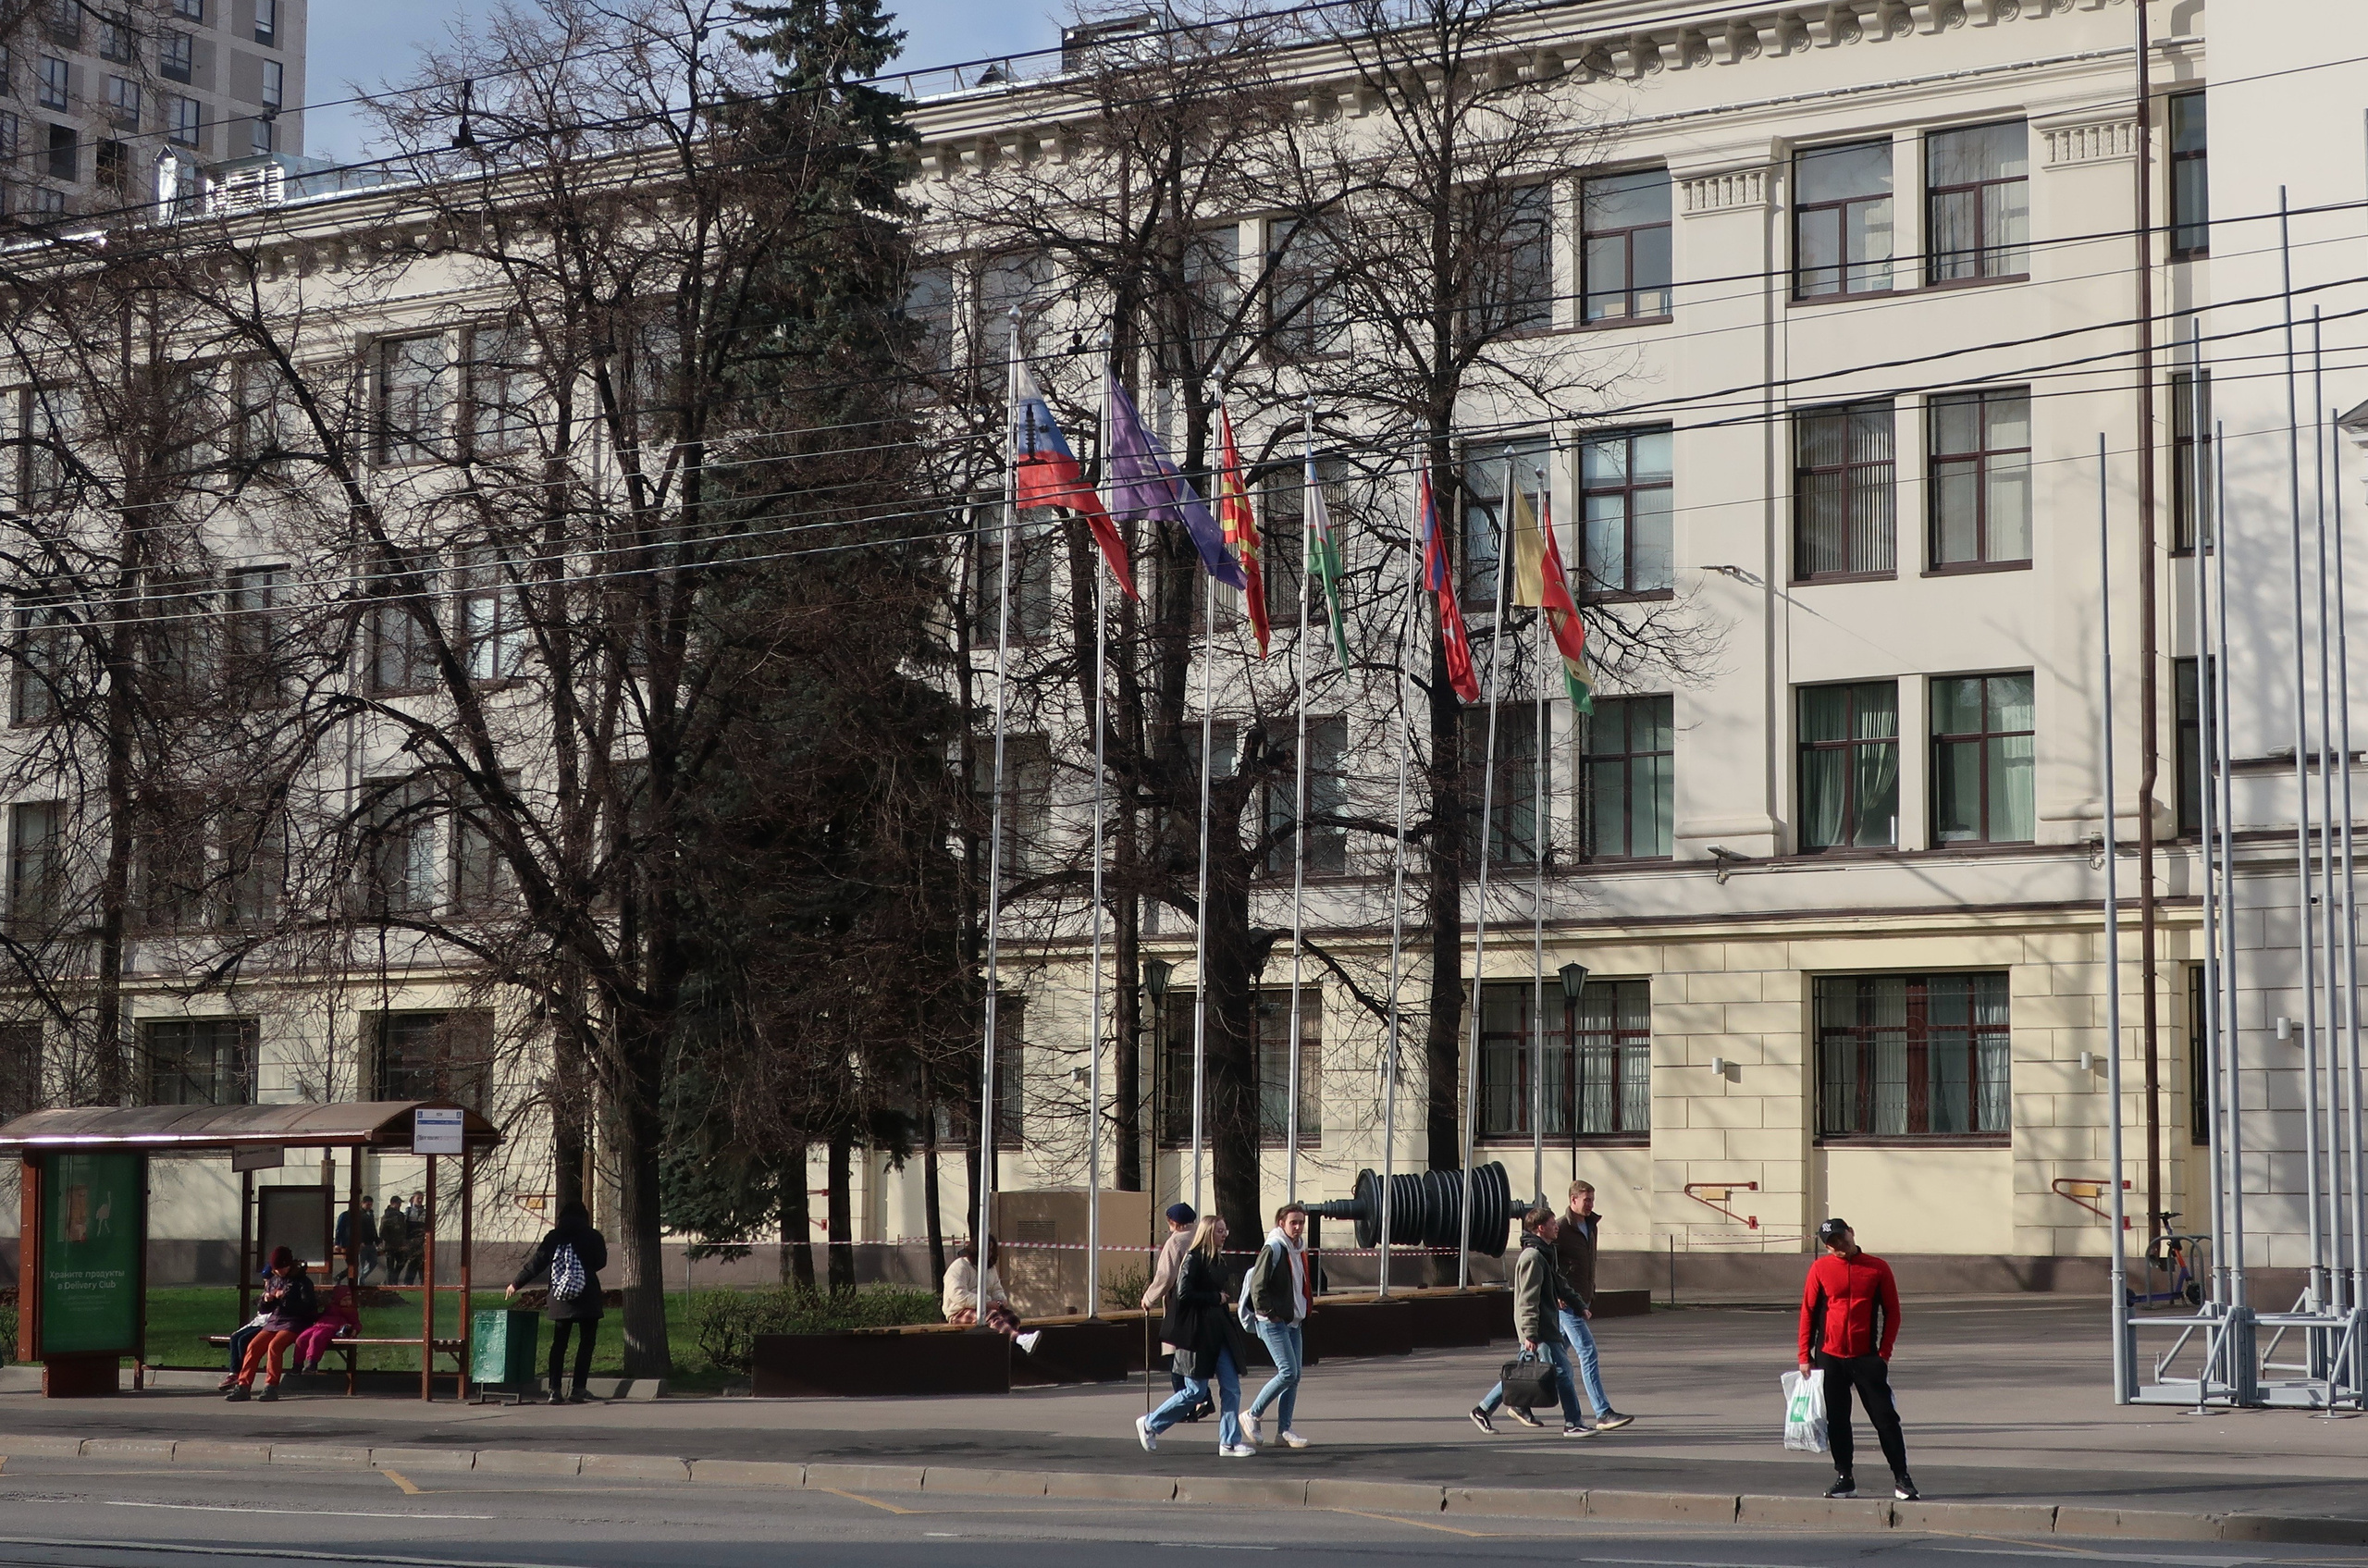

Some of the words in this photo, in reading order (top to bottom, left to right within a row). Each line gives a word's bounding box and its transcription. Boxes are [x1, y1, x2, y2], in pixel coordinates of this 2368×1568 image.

[49, 1270, 83, 1279] Храните
[85, 1270, 125, 1278] продукты
[64, 1281, 97, 1290] Delivery
[98, 1279, 117, 1289] Club
